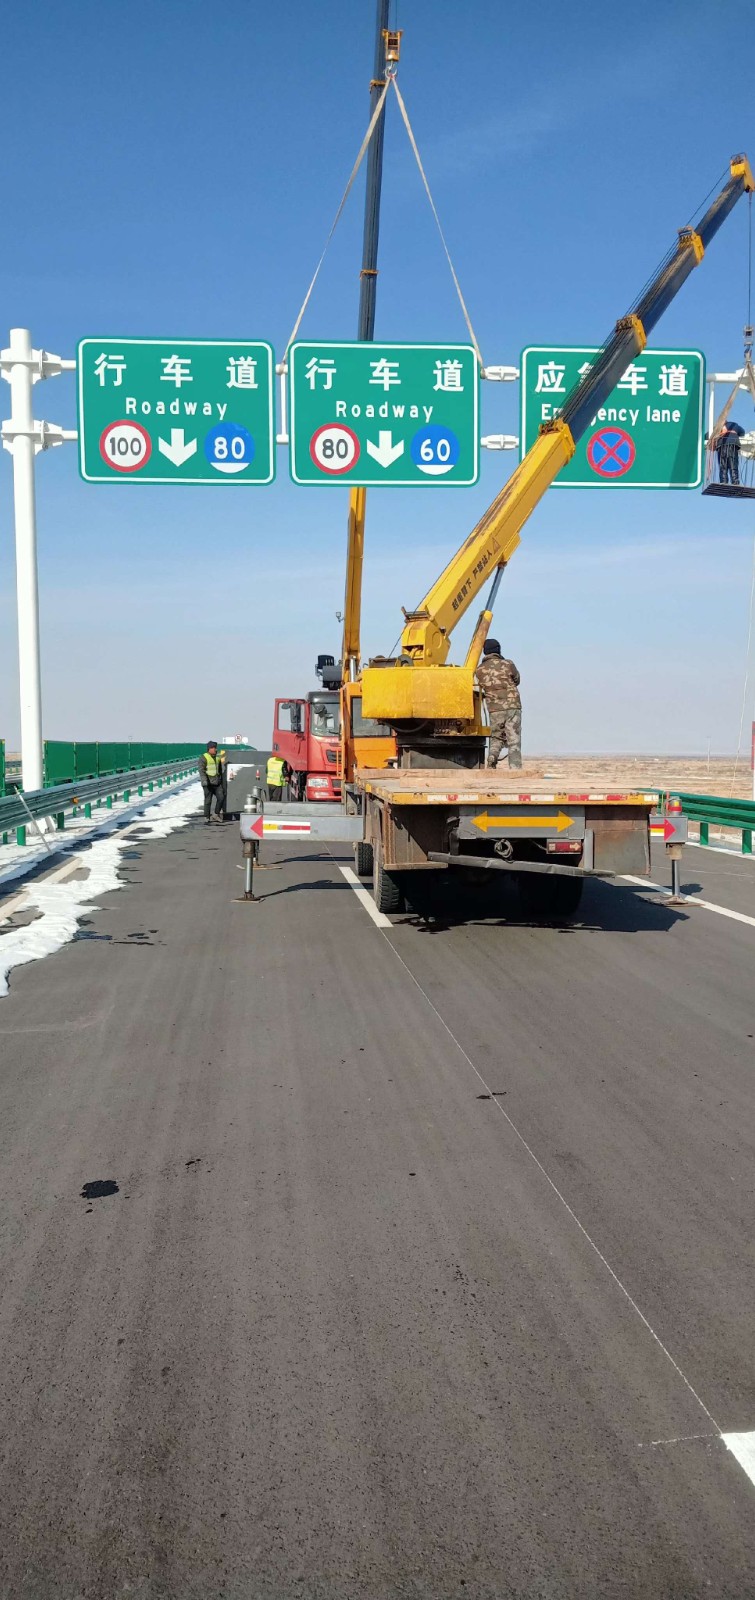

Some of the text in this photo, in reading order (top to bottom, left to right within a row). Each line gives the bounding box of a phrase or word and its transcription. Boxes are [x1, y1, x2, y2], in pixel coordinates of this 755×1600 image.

[94, 352, 258, 389] 行车道
[304, 357, 464, 392] 行车道
[534, 361, 689, 396] 应车道
[125, 397, 228, 421] Roadway
[335, 400, 434, 423] Roadway
[541, 403, 681, 426] Eency lane
[109, 437, 142, 456] 100
[214, 436, 245, 459] 80
[322, 438, 348, 459] 80
[420, 438, 450, 462] 60
